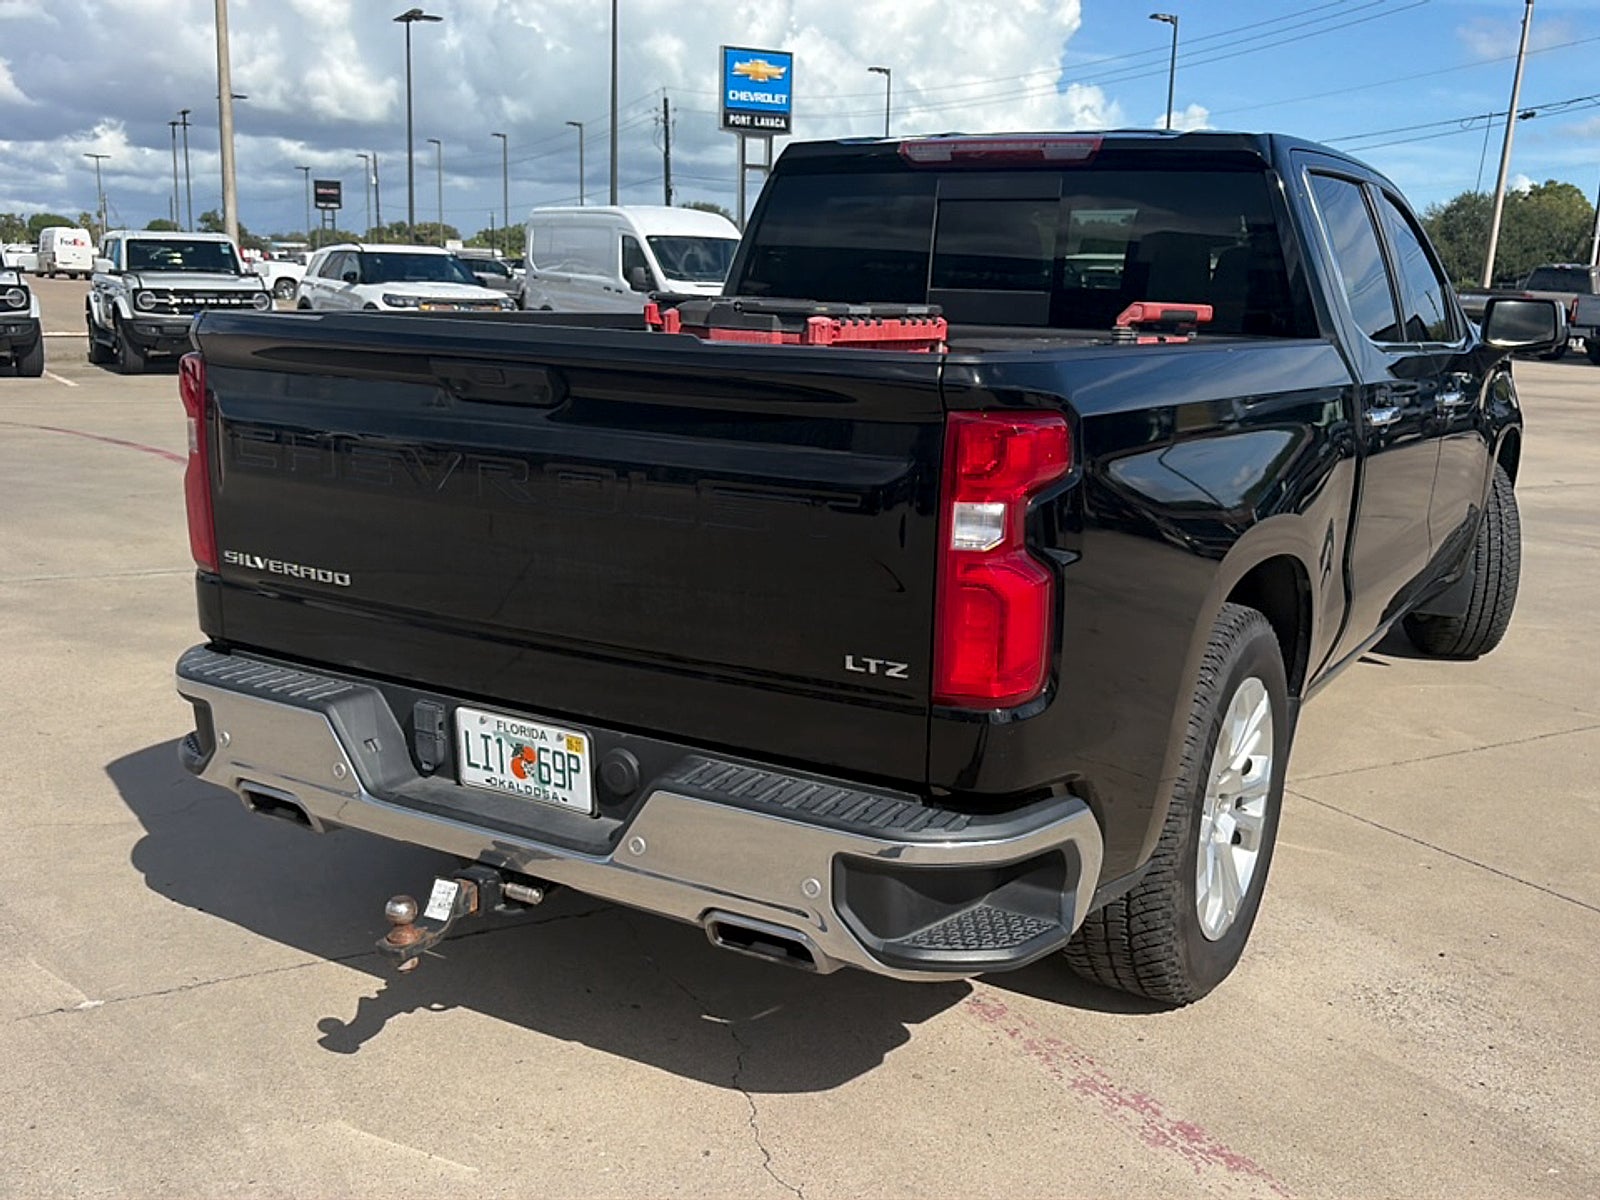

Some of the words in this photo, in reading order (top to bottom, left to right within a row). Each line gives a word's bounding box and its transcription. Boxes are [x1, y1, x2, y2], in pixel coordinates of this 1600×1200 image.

[728, 90, 788, 104] CHEVROLET
[729, 115, 751, 126] PORT
[754, 116, 786, 128] LAVACA
[223, 549, 351, 586] SILVERADO
[845, 655, 908, 678] LTZ
[496, 720, 548, 742] FLORIDA
